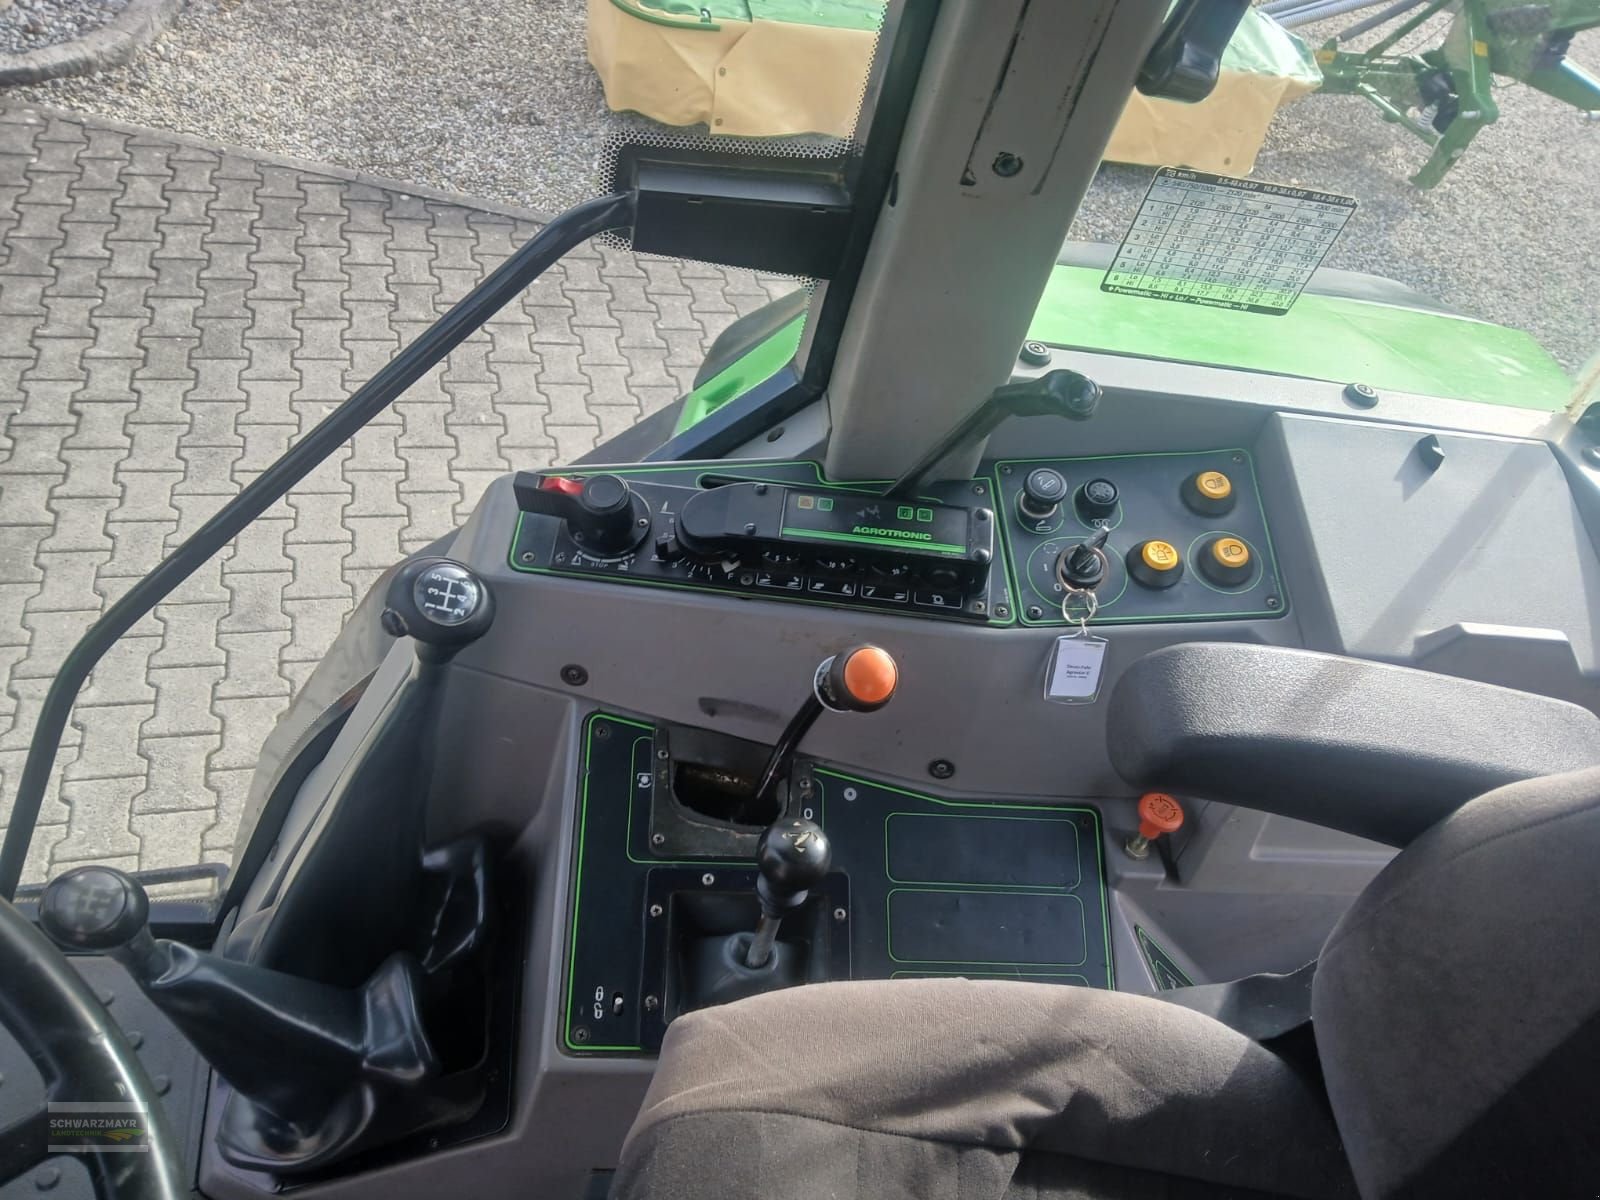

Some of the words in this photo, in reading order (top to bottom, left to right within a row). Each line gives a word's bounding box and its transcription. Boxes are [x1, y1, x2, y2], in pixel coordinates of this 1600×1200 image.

[853, 526, 932, 540] AGROTRONIC
[431, 573, 442, 582] 5
[428, 587, 439, 596] 3
[456, 594, 468, 602] 4
[454, 608, 466, 616] 2
